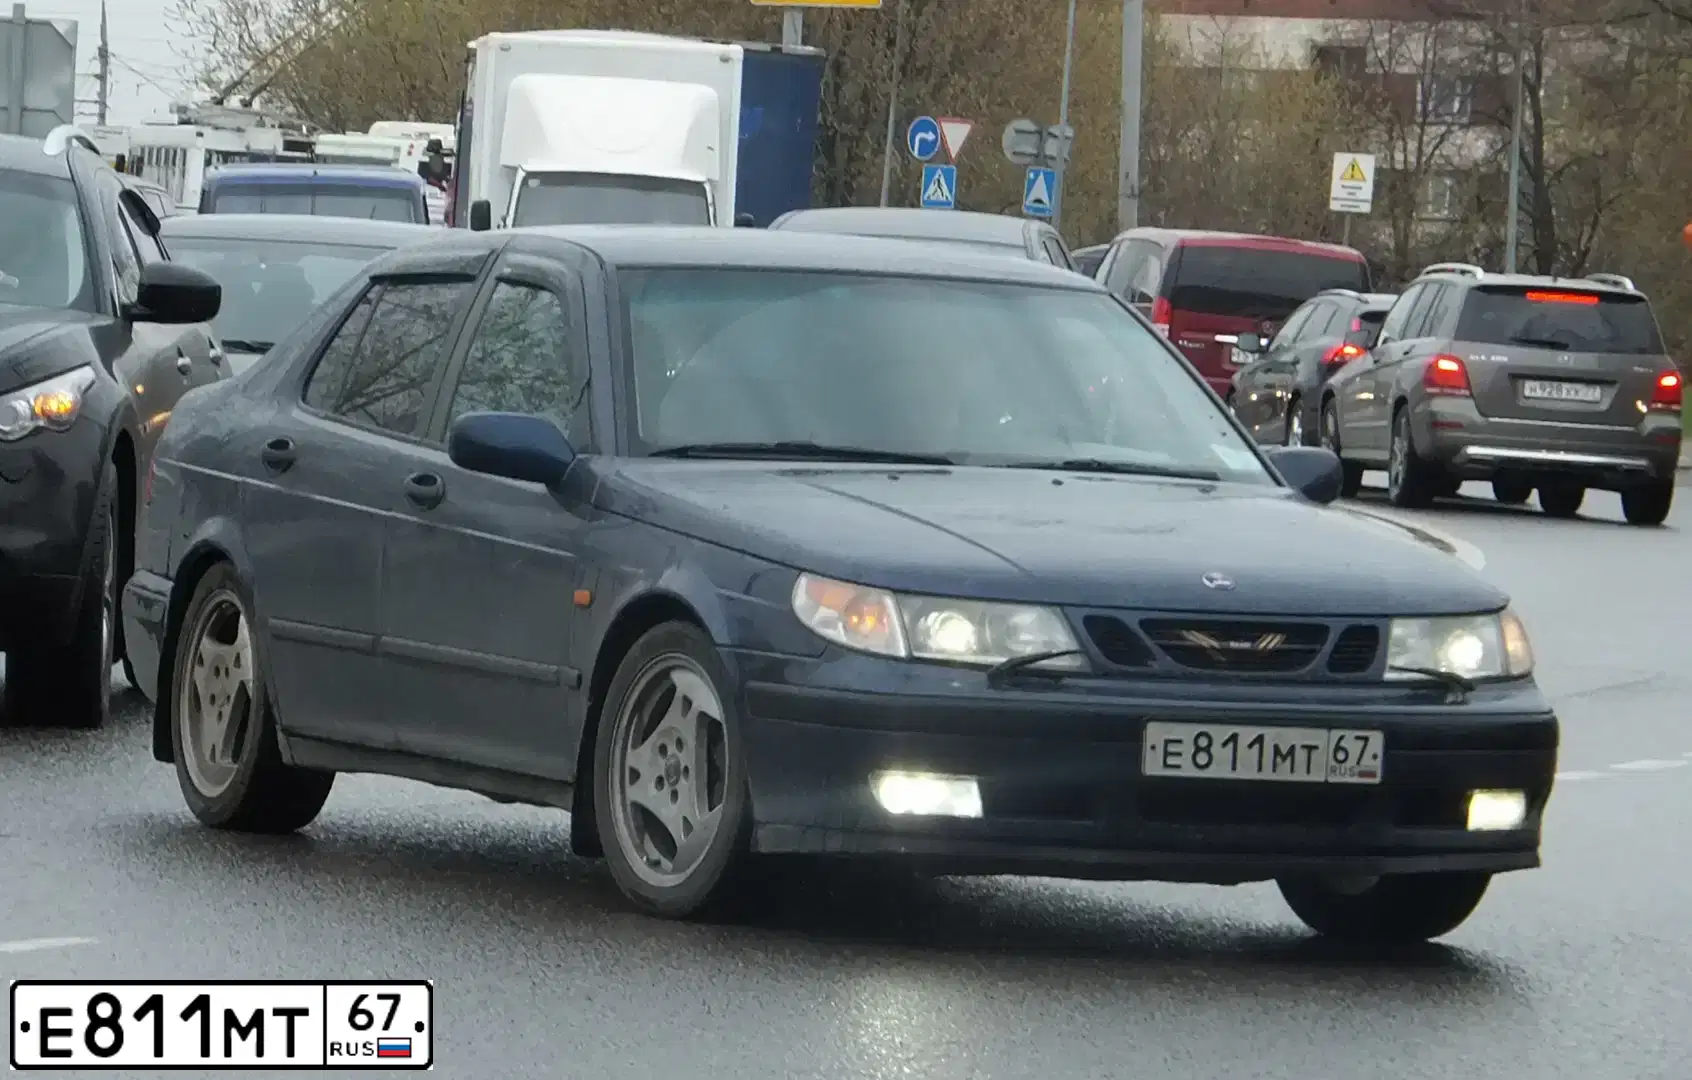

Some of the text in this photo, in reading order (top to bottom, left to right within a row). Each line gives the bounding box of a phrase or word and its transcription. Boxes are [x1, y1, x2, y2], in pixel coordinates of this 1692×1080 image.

[1162, 731, 1370, 775] Е811МТ 67
[1329, 766, 1358, 778] RUS
